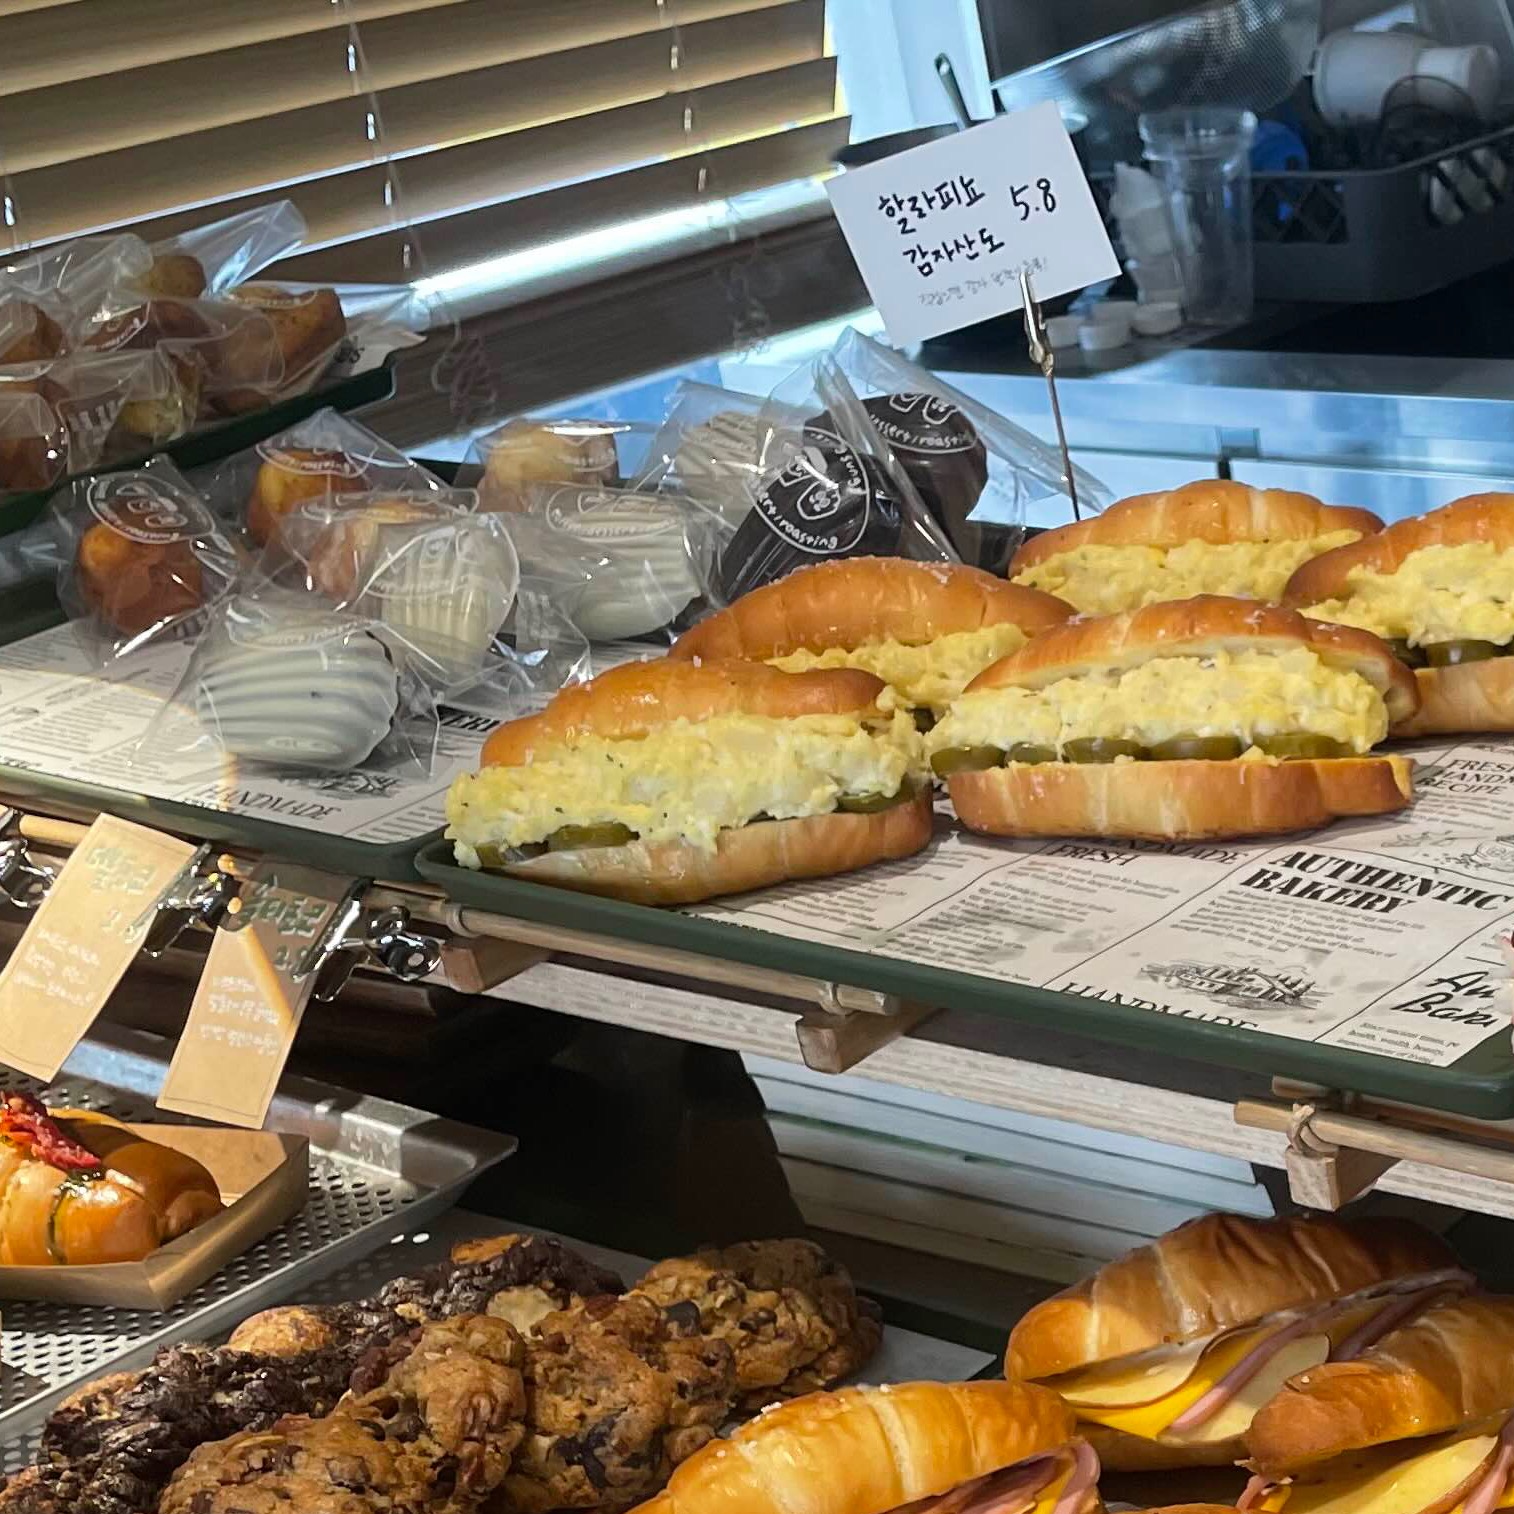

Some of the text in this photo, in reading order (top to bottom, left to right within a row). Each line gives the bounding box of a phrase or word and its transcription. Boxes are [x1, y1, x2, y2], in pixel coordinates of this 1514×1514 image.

[877, 175, 1058, 235] 할라피뇨 5.8
[902, 227, 1005, 277] 감자산도
[1415, 776, 1509, 796] RECIPE
[1048, 844, 1142, 867] FRESH
[1240, 868, 1417, 914] BAKERY
[1269, 851, 1514, 910] AUTHENTIC
